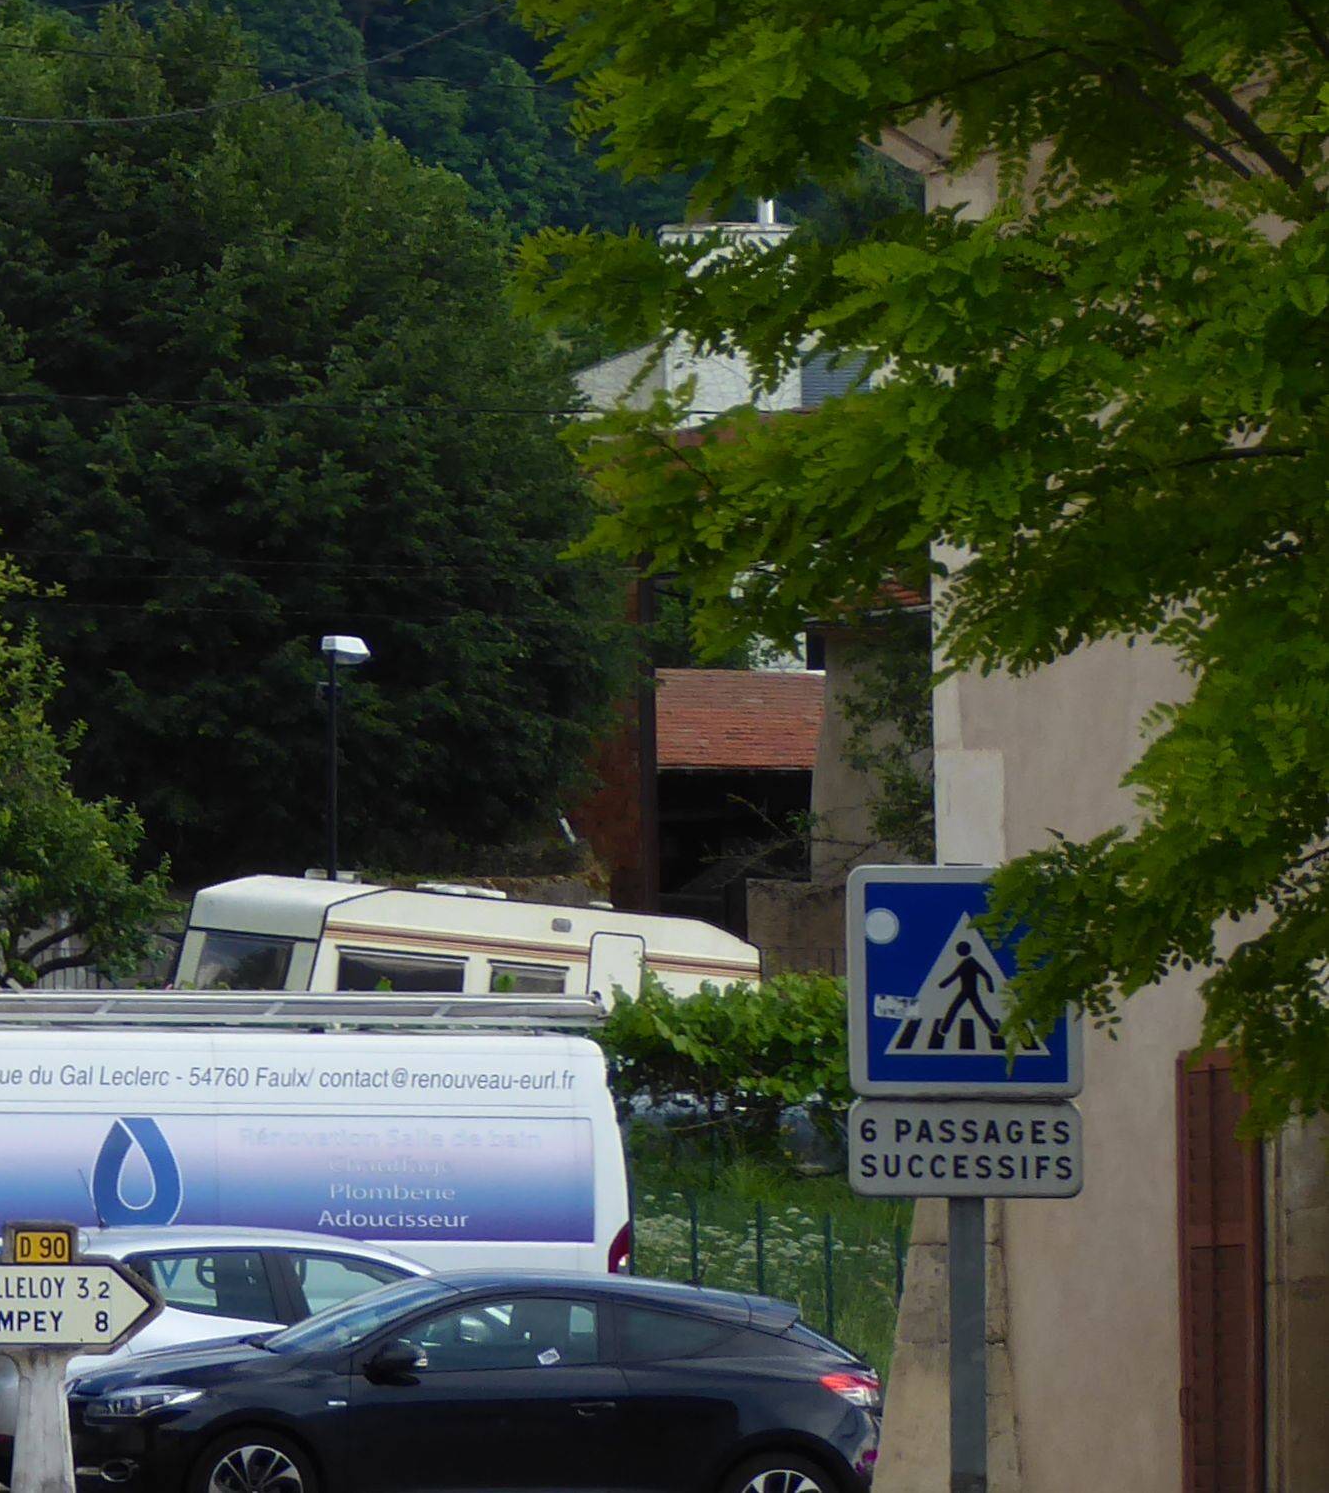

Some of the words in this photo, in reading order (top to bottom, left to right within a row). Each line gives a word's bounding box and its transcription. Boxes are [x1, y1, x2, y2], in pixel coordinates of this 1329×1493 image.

[29, 1065, 53, 1086] du
[59, 1064, 92, 1086] Gal
[99, 1066, 170, 1087] Leclerc
[189, 1067, 249, 1088] 54760
[860, 1118, 878, 1143] 6
[894, 1119, 1071, 1145] PASSAGES
[860, 1154, 1073, 1180] SUCCESSIFS
[330, 1183, 456, 1201] Plomberie
[317, 1210, 470, 1228] Adoucisseur
[21, 1237, 32, 1258] D
[39, 1237, 66, 1258] 90
[95, 1311, 109, 1332] 8
